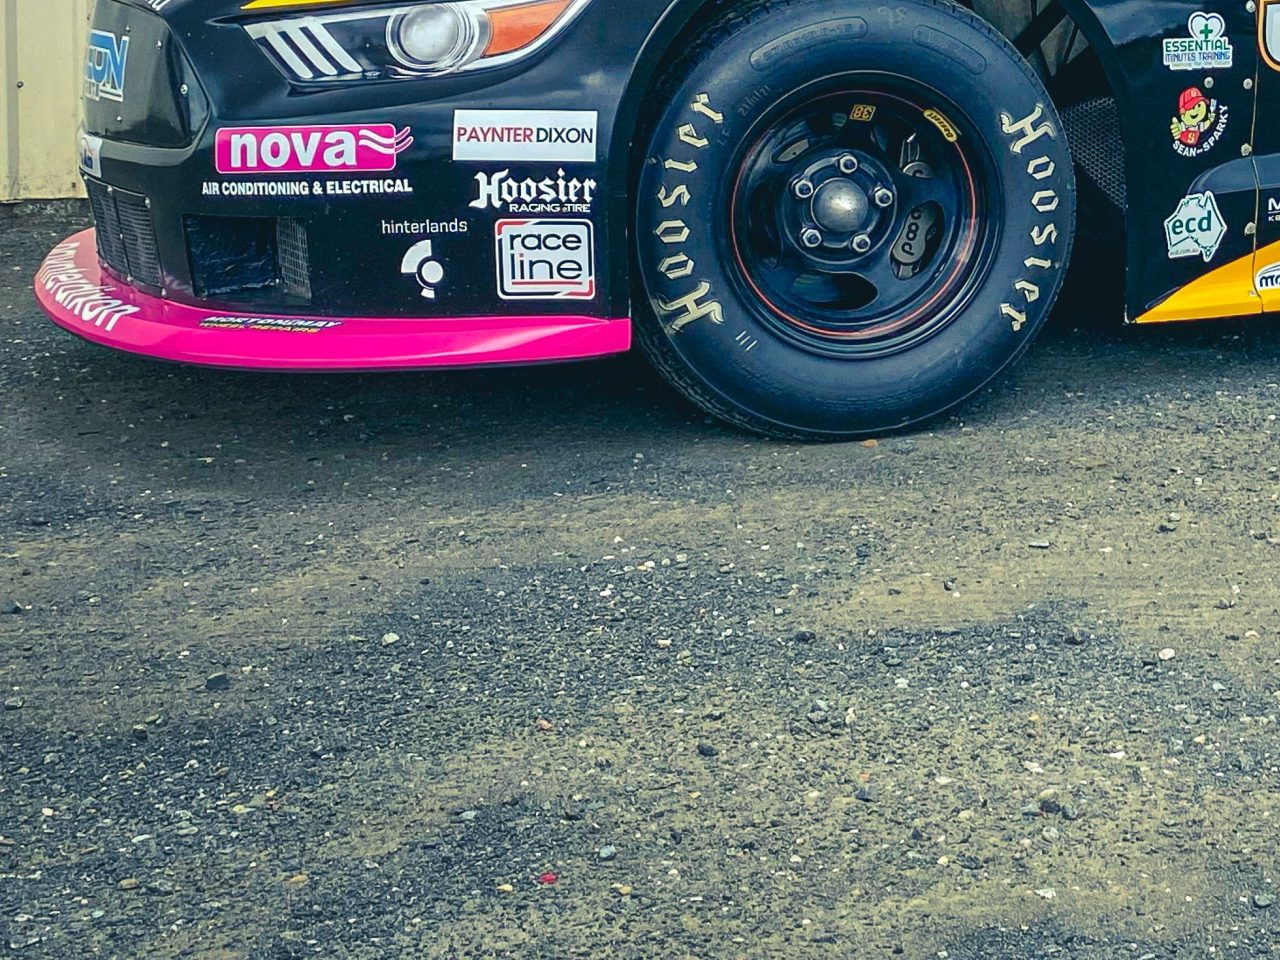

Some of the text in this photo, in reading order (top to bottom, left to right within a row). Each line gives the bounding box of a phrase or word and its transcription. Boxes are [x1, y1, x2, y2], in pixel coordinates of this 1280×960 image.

[1165, 40, 1231, 53] ESSENTIAL
[853, 106, 874, 121] 38
[456, 126, 594, 144] PAYNTER DIXON
[230, 130, 358, 168] nova
[202, 178, 413, 196] AIR CONDITIONING & ELECTRICAL
[468, 167, 597, 209] Hoosier
[508, 203, 560, 213] RACING
[657, 93, 724, 333] Hoosier
[381, 218, 468, 235] hinterlands
[1000, 103, 1058, 332] Hoosier
[1171, 209, 1213, 236] ecd
[508, 233, 582, 251] race
[509, 252, 583, 280] line
